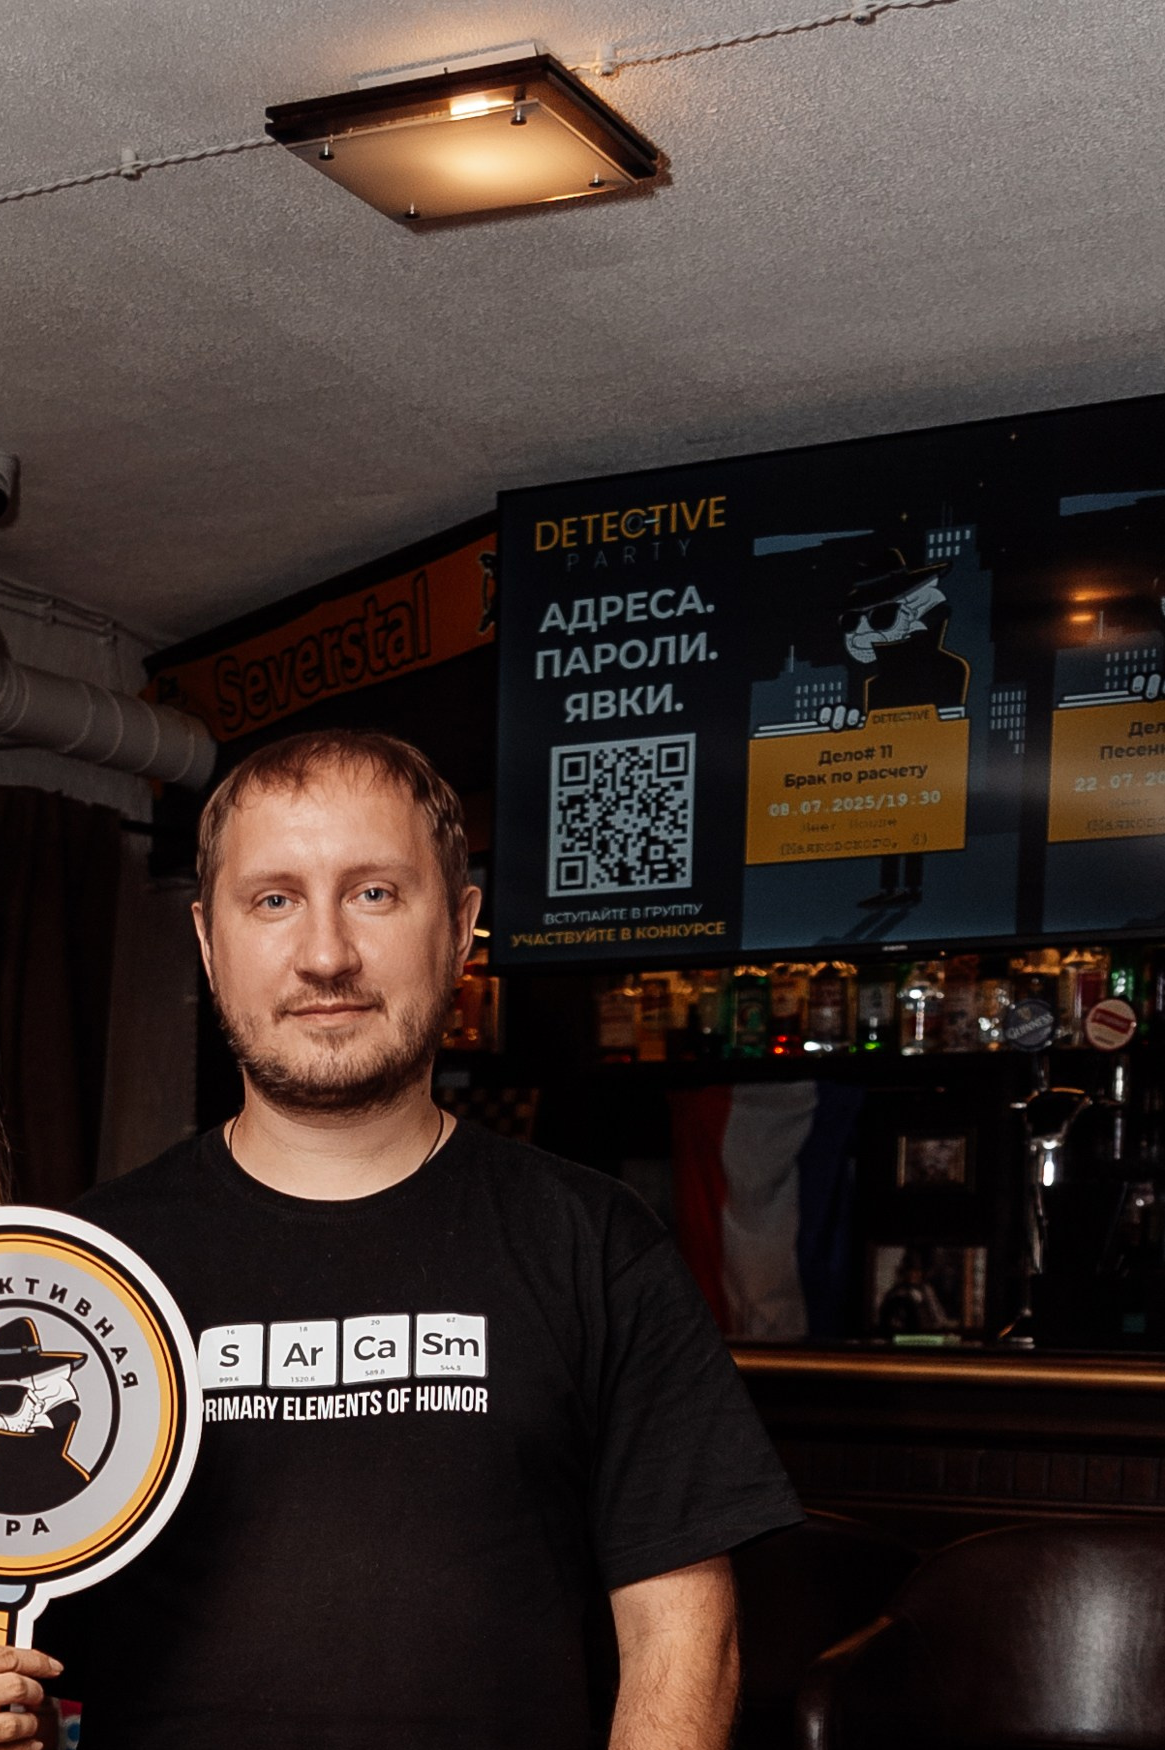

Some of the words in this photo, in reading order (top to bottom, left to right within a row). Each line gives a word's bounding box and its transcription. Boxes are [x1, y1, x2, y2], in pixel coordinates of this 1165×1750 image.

[534, 495, 727, 552] DETECTIVE
[566, 538, 691, 573] PARTY
[538, 584, 715, 636] АДРЕСА.
[214, 569, 431, 732] Severstal
[534, 631, 719, 681] ПАРОЛИ.
[564, 682, 684, 724] ЯВКИ.
[817, 746, 875, 767] Дело#
[880, 745, 893, 759] 11
[783, 773, 827, 789] Брак
[831, 770, 853, 784] по
[855, 763, 929, 784] расчету
[543, 906, 628, 925] ВСТУПАЙТЕ
[631, 907, 642, 920] В
[643, 903, 704, 919] ГРУППУ
[510, 926, 616, 949] УЧАСТВУЙТЕ
[620, 927, 632, 941] В
[635, 920, 727, 940] КОНКУРСЕ
[370, 1318, 381, 1326] 20
[219, 1343, 240, 1368] S
[282, 1342, 324, 1368] Ar
[353, 1335, 396, 1361] Ca
[422, 1332, 479, 1357] Sm
[202, 1395, 278, 1423] RIMARY
[283, 1391, 383, 1421] ELEMENTS
[386, 1387, 412, 1414] OF
[415, 1385, 489, 1414] HUMOR
